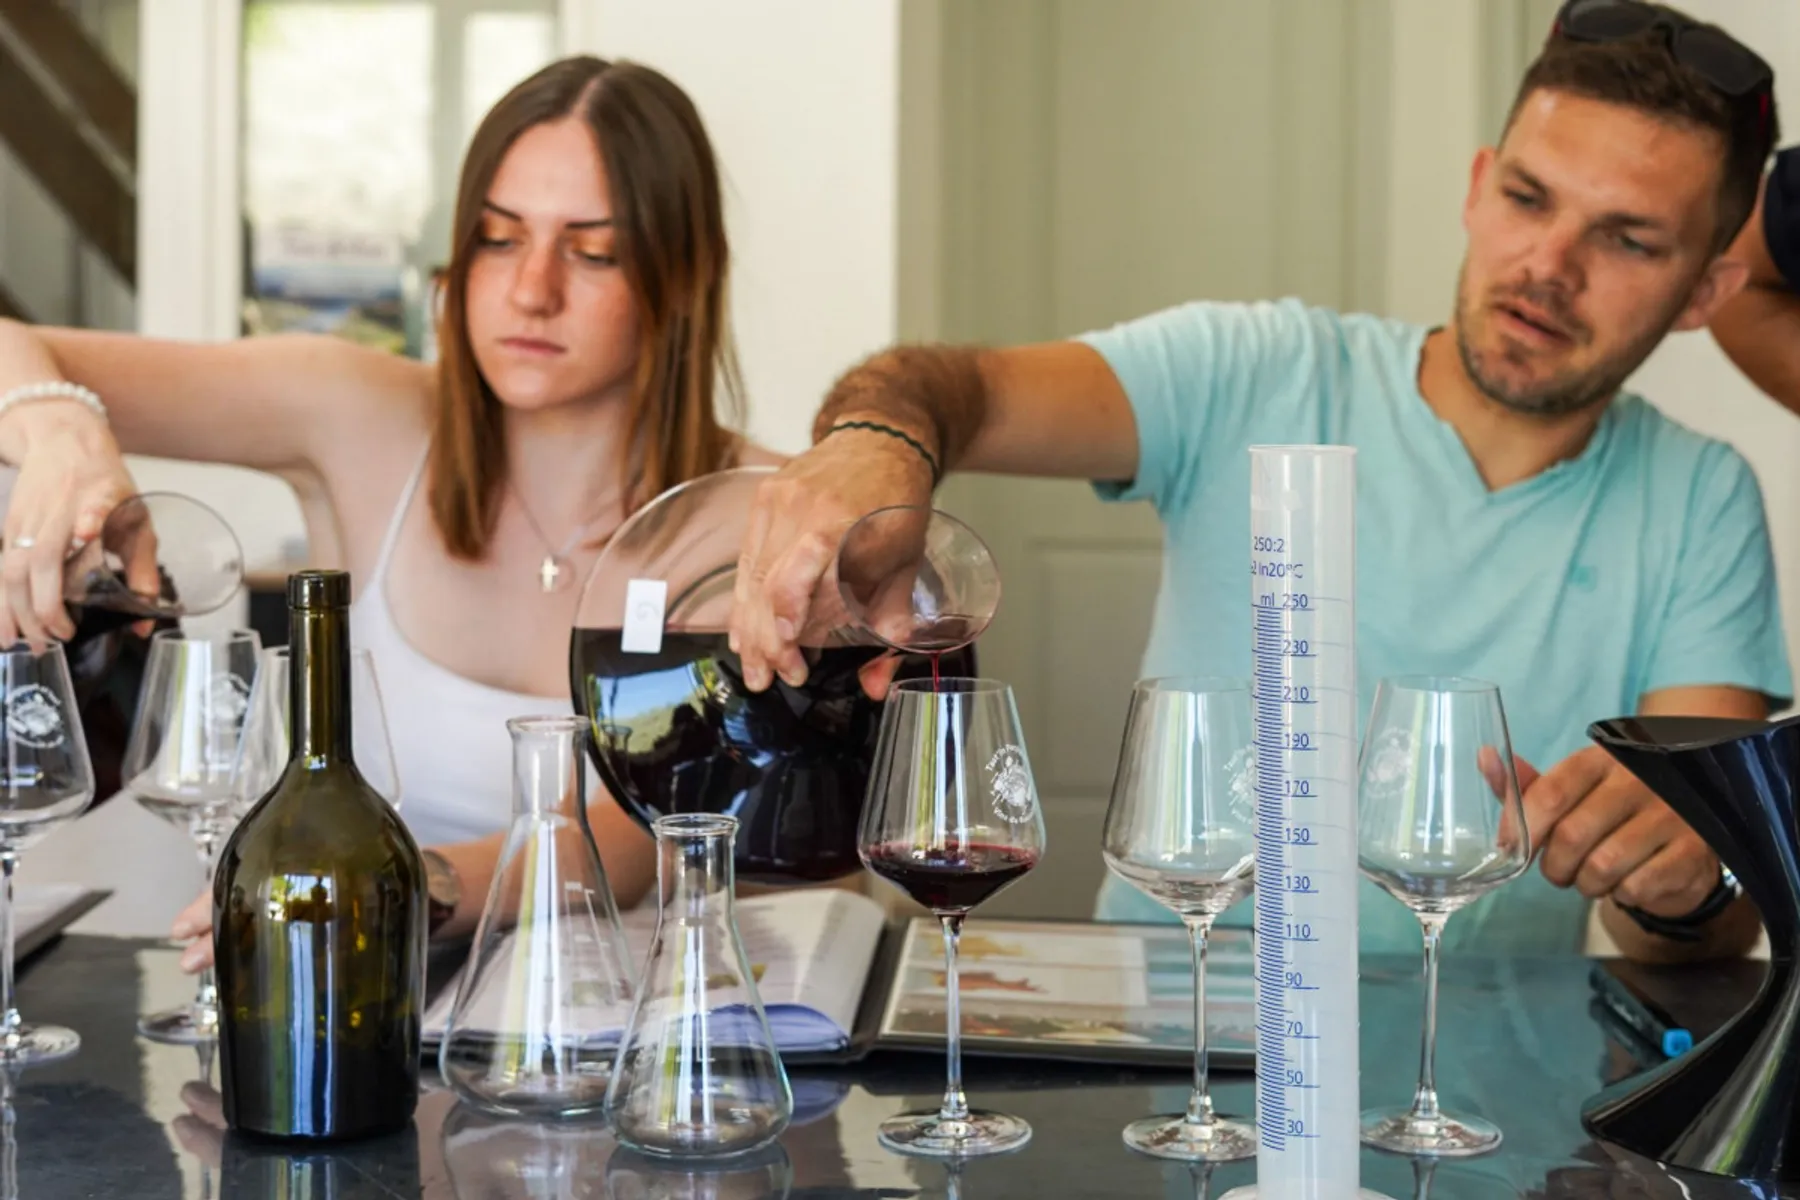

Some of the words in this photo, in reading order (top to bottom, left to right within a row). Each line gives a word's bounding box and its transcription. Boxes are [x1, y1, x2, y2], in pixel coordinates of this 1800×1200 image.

[1261, 592, 1275, 607] ml
[1282, 593, 1309, 608] 250
[1283, 639, 1309, 654] 230
[1283, 686, 1309, 701] 210
[1285, 733, 1310, 748] 190
[1285, 780, 1310, 795] 170
[1286, 828, 1310, 842] 150
[1286, 876, 1311, 890] 130
[1286, 924, 1311, 938] 110
[1285, 972, 1303, 986] 90
[1286, 1020, 1303, 1035] 70
[1286, 1070, 1303, 1084] 50
[1287, 1119, 1304, 1134] 30
